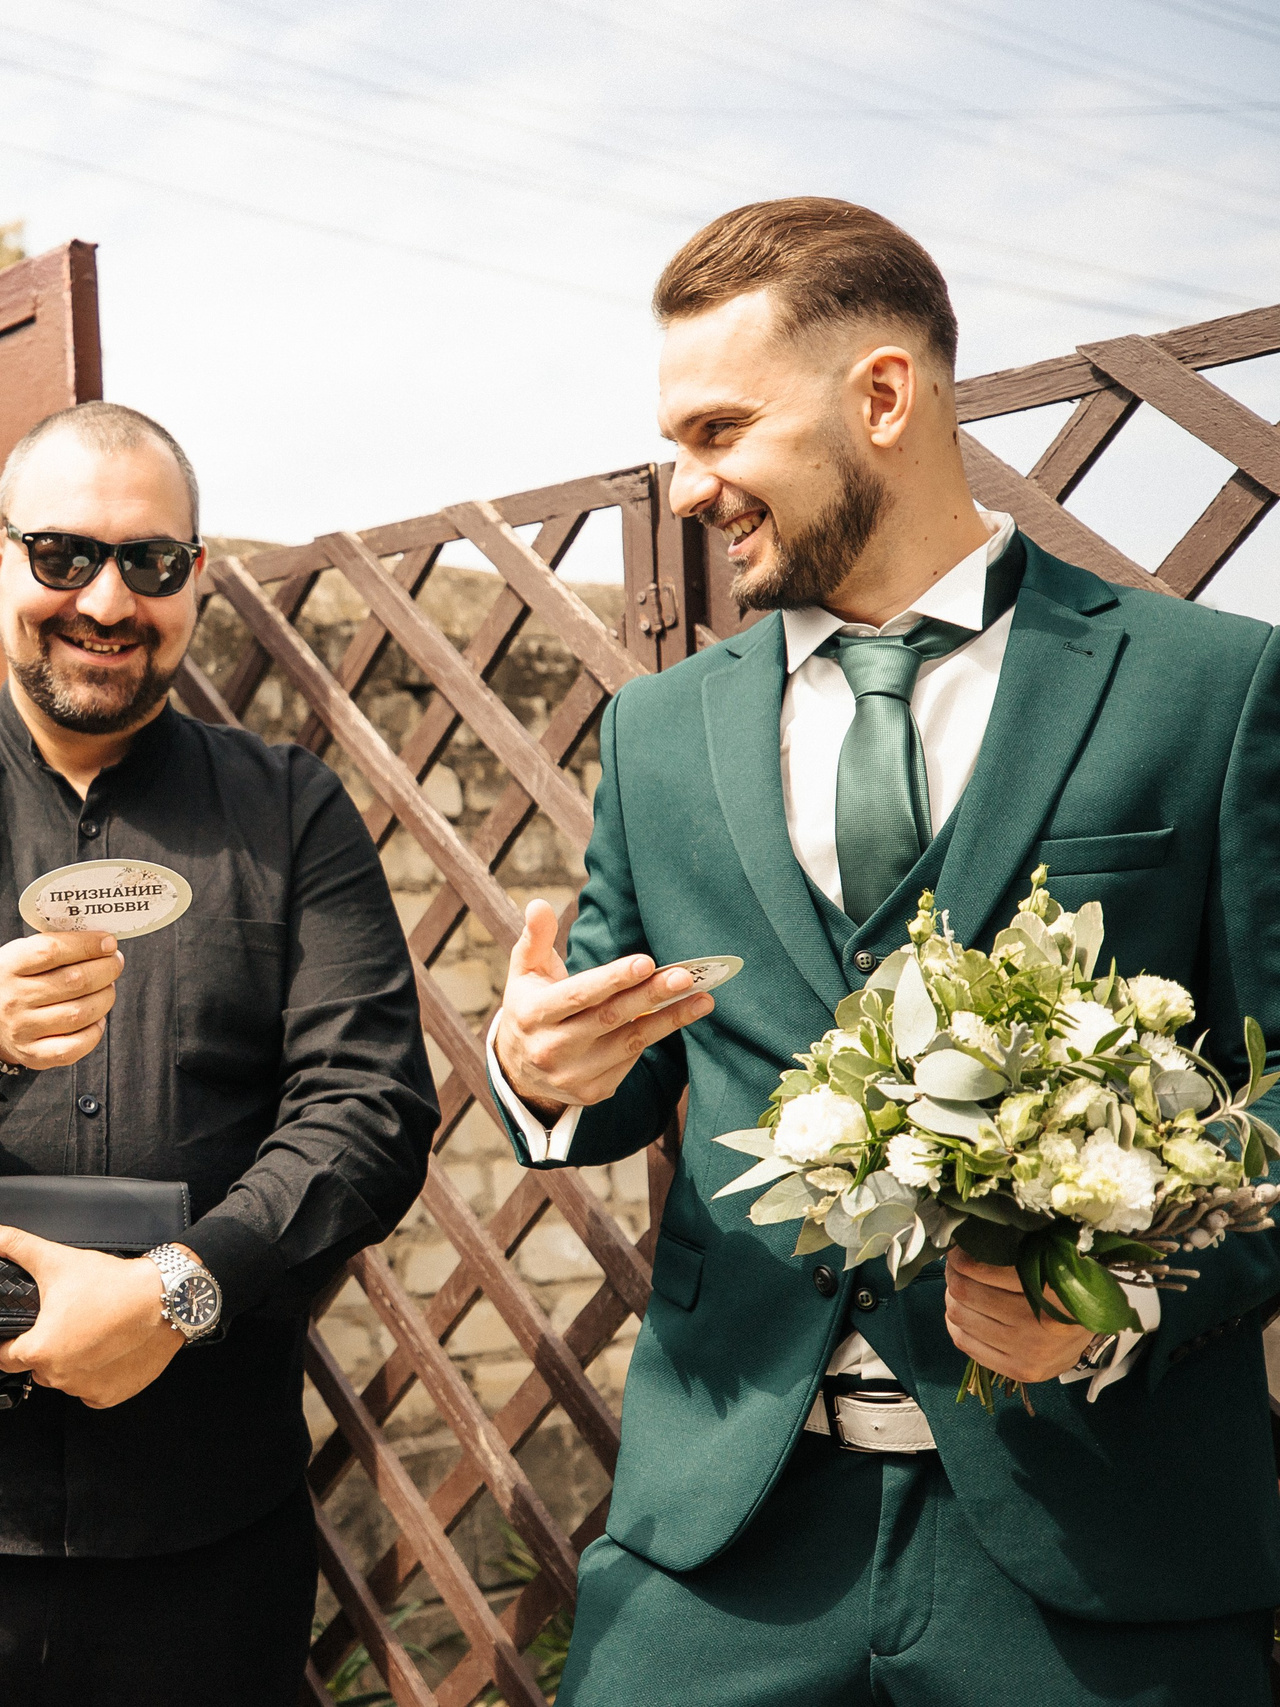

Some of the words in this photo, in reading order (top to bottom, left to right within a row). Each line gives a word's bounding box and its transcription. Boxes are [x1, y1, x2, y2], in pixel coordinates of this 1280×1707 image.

[50, 884, 163, 903] ПРИЗНАНИЕ
[69, 905, 81, 917] В
[85, 901, 150, 916] ЛЮБВИ
